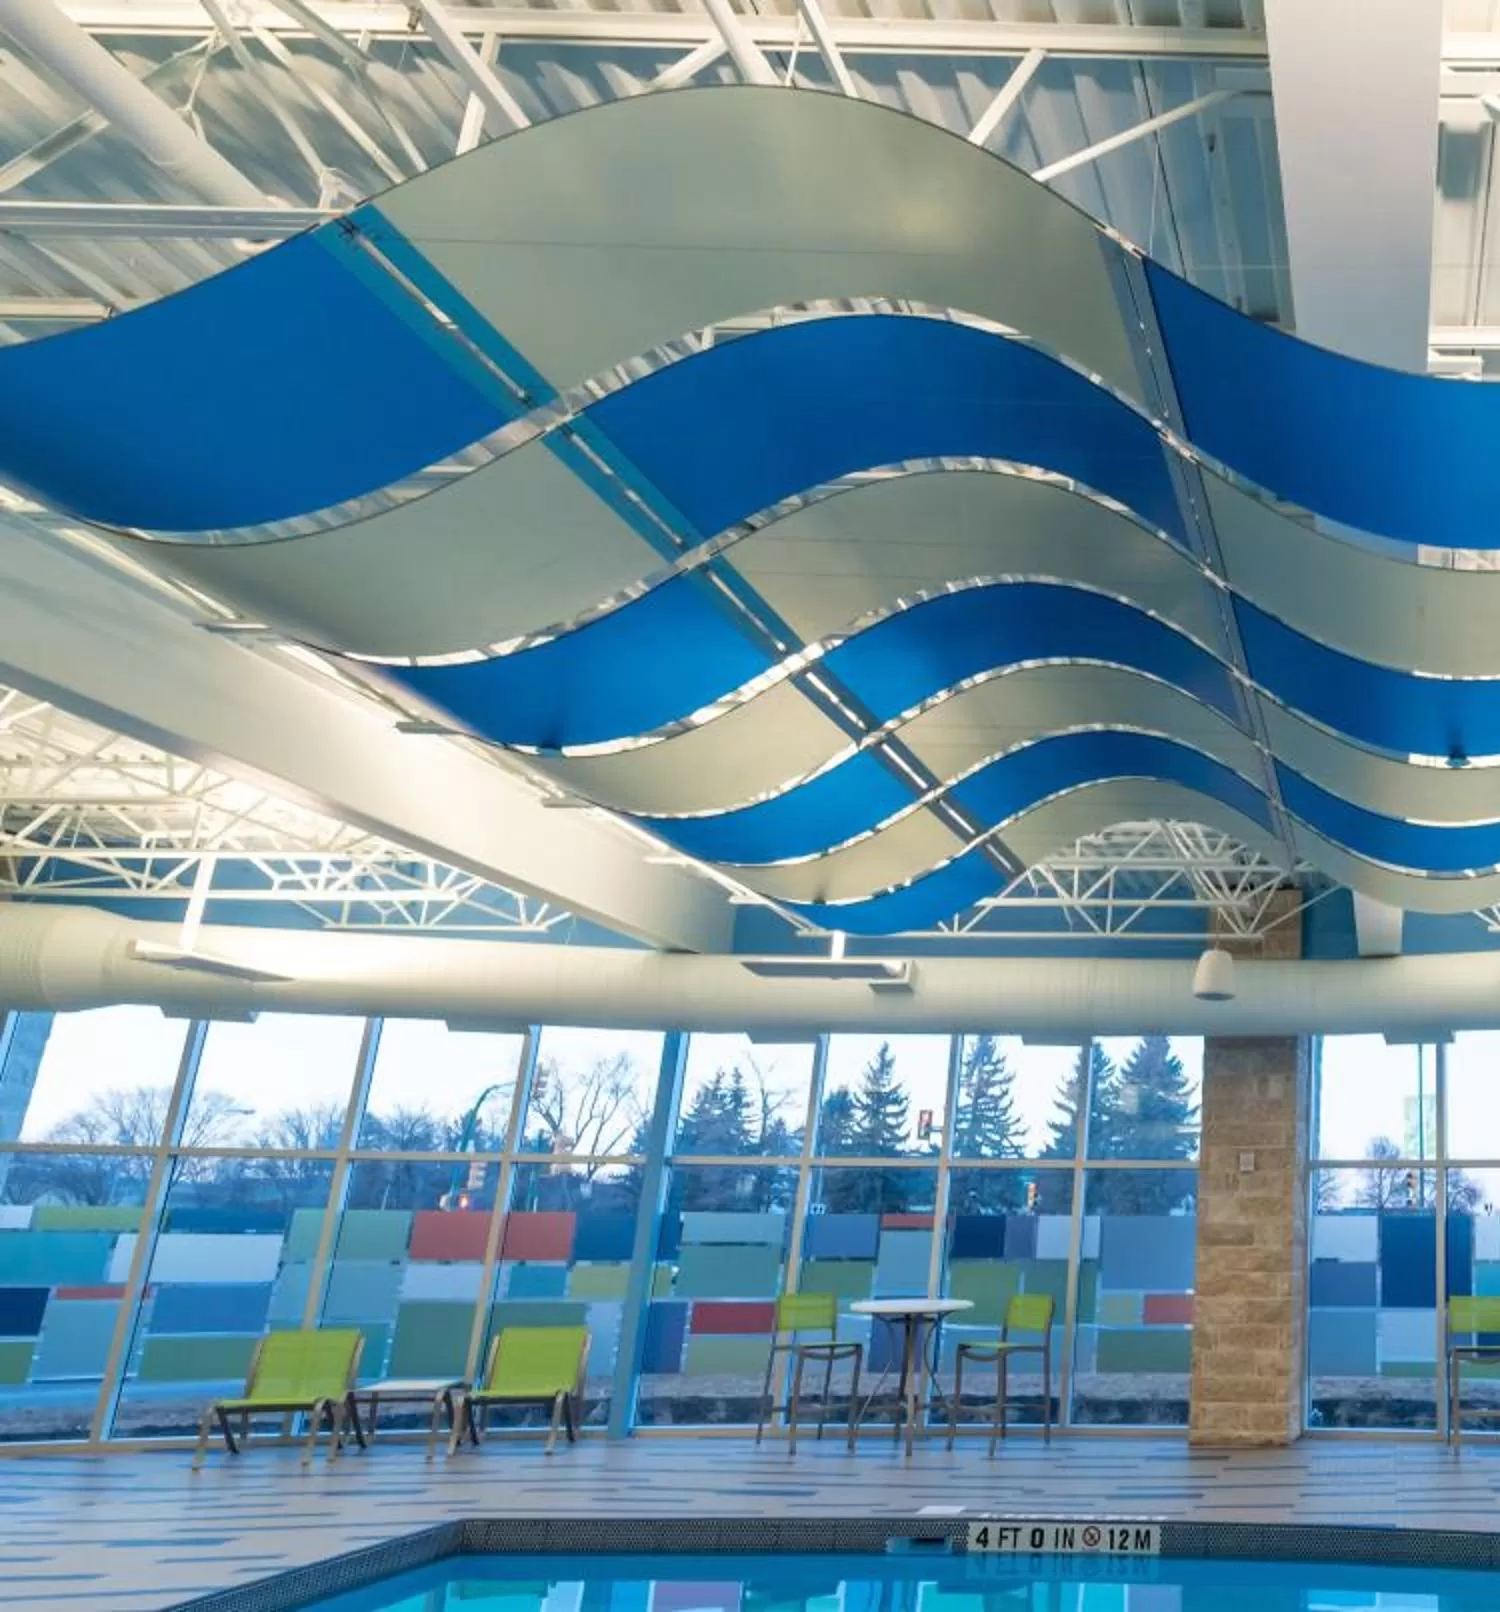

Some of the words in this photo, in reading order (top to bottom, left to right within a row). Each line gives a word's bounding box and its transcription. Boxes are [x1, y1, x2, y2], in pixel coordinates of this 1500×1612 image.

[975, 1526, 989, 1548] 4
[998, 1527, 1023, 1548] FT
[1030, 1527, 1044, 1548] 0
[1055, 1527, 1075, 1549] IN
